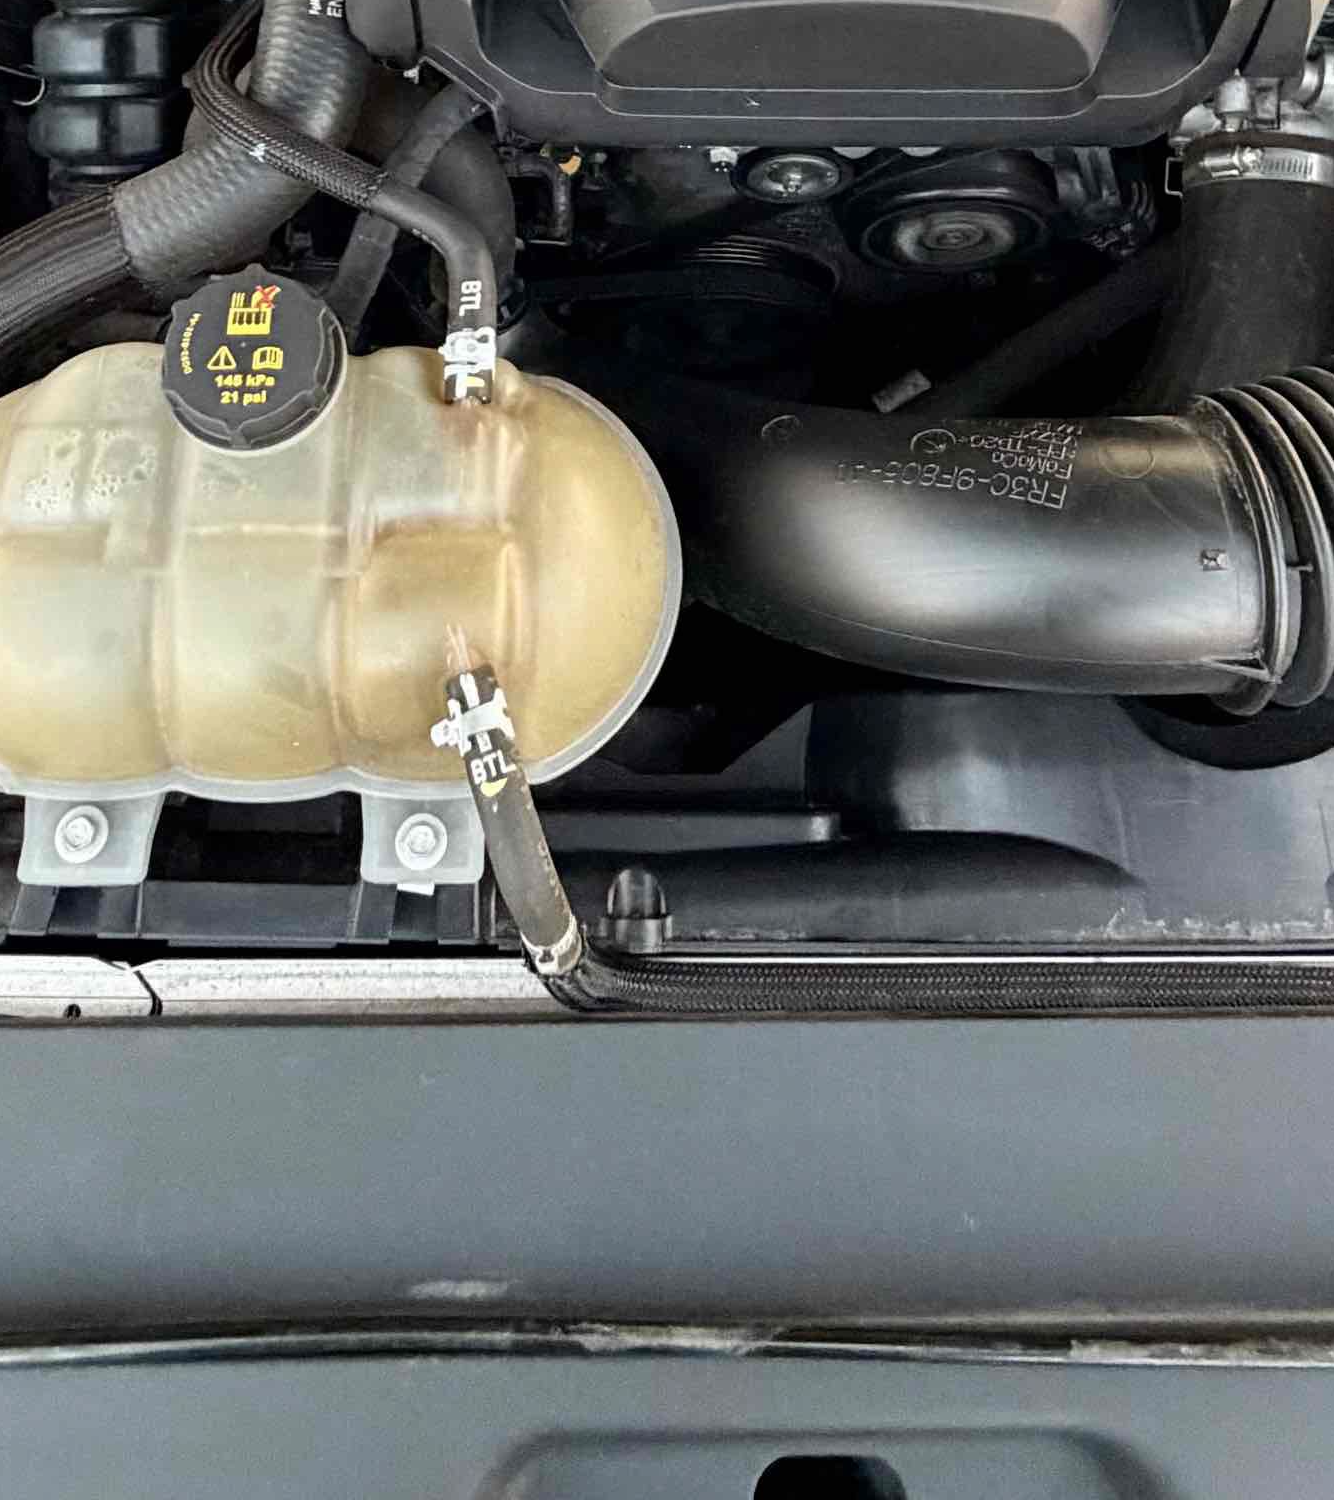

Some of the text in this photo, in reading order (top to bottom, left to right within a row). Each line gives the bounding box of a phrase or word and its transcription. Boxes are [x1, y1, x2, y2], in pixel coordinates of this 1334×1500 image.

[459, 280, 482, 316] BTL
[246, 374, 276, 387] kPa
[220, 390, 267, 407] 21 psi
[991, 452, 1073, 480] FoMoCo
[470, 750, 516, 784] BTL
